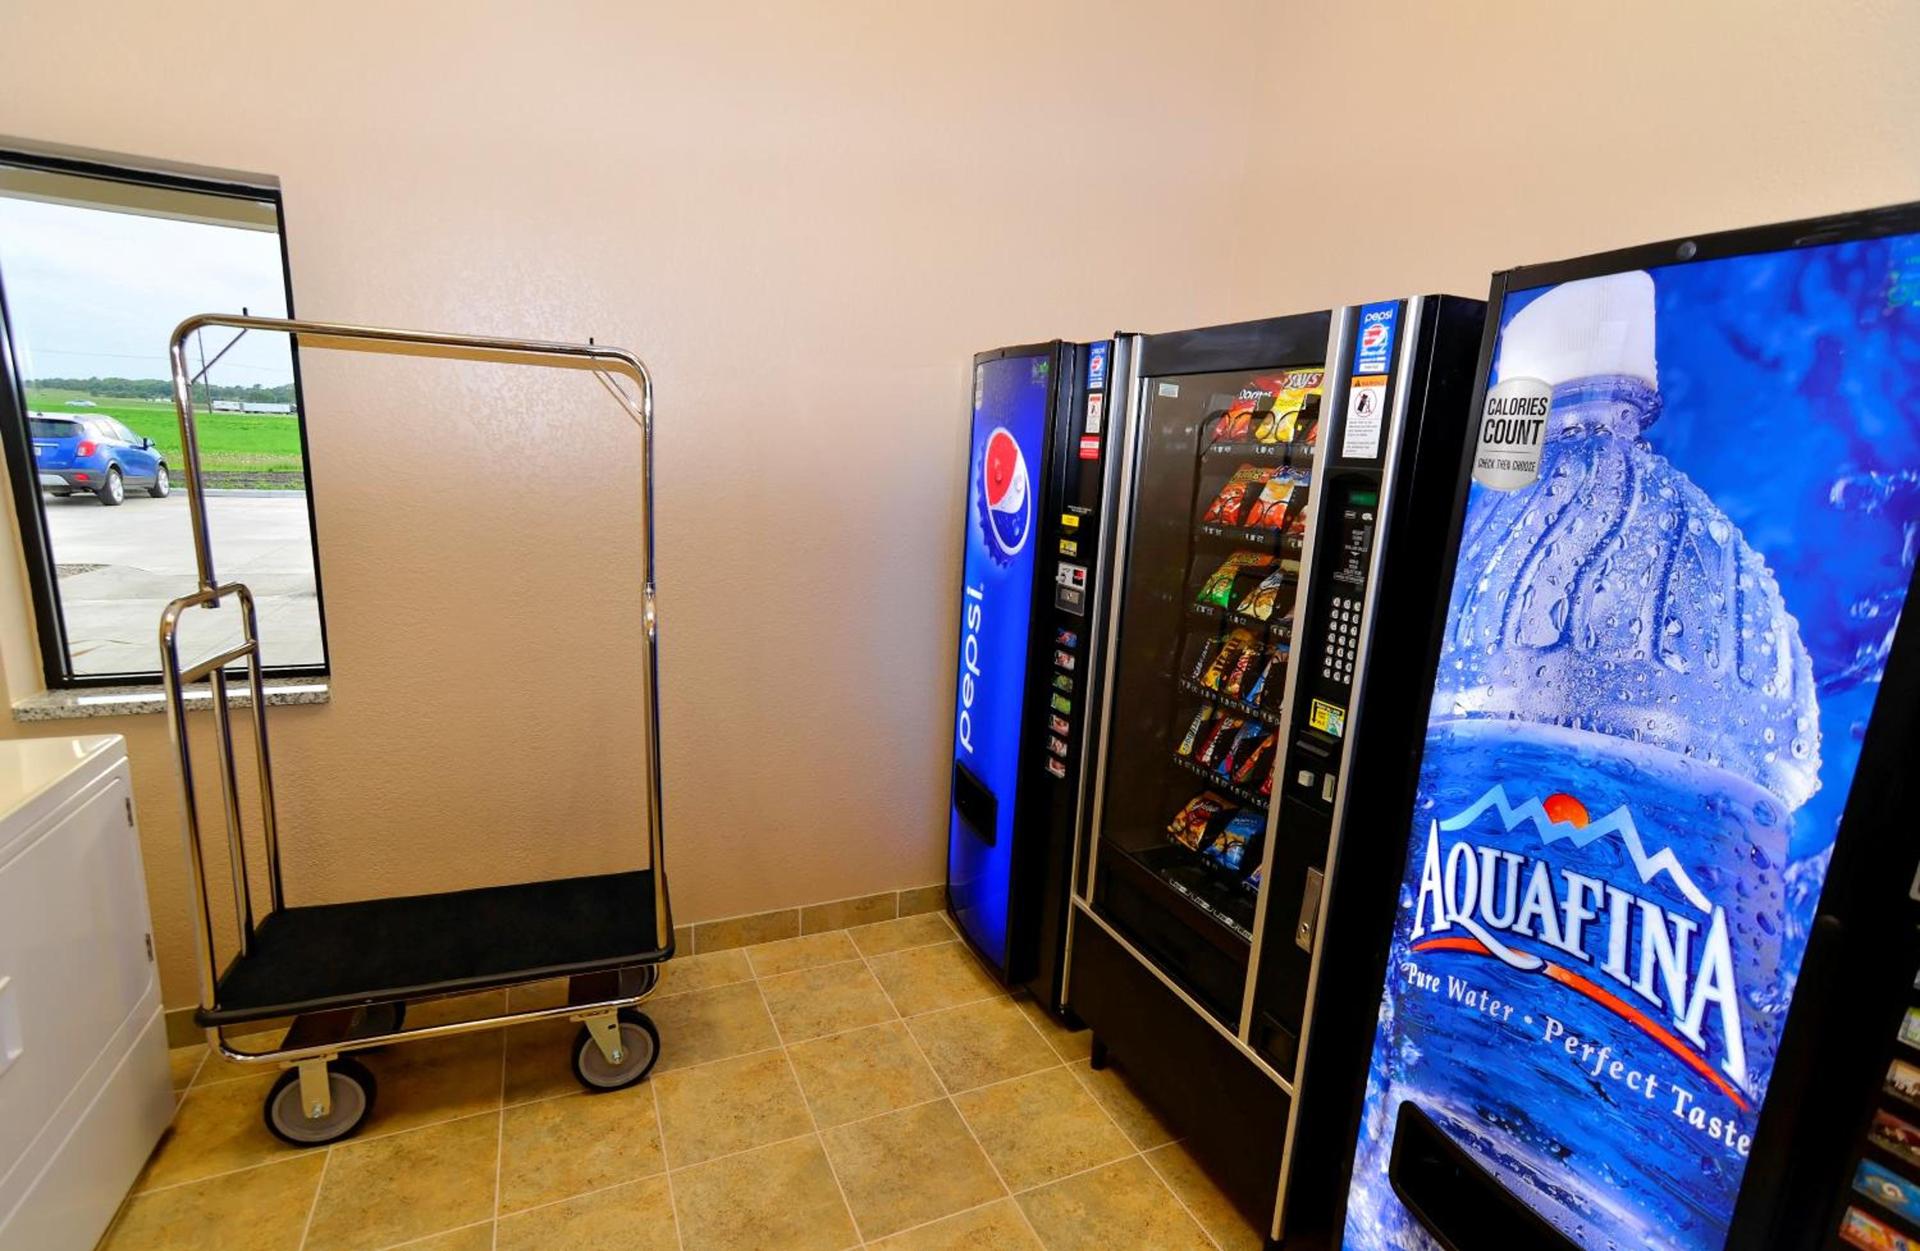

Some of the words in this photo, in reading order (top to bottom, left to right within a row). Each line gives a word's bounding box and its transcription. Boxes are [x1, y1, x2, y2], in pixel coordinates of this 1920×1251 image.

[1364, 308, 1393, 324] pepsi
[1488, 397, 1548, 416] CALORIES
[1483, 418, 1544, 445] COUNT
[1478, 458, 1495, 469] CHECK
[959, 585, 984, 753] pepsi
[1410, 818, 1750, 1093] AQUAFINA
[1401, 961, 1440, 993] Pure
[1447, 974, 1514, 1021] Water
[1542, 1015, 1659, 1100] Perfect
[1671, 1084, 1751, 1157] Taste
